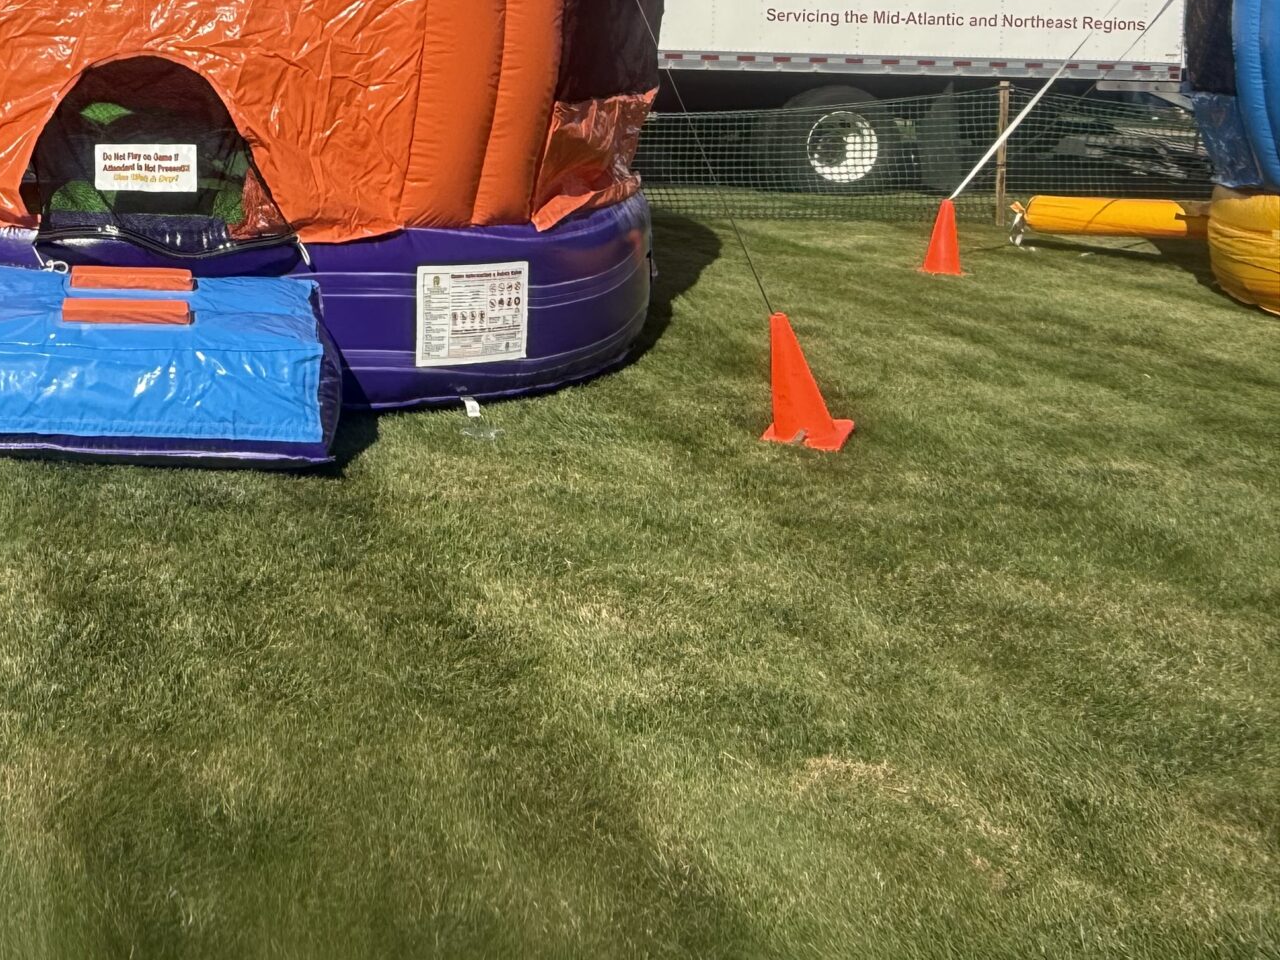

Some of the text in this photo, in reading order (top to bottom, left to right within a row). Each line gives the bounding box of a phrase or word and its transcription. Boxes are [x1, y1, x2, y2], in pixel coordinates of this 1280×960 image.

[766, 8, 1147, 34] Servicing the Mid-Atlantic and Northeast Regions
[102, 152, 112, 161] Do
[114, 152, 126, 161] Not
[127, 152, 142, 161] Play
[143, 153, 152, 161] on
[153, 152, 172, 161] Game
[144, 163, 156, 172] Not
